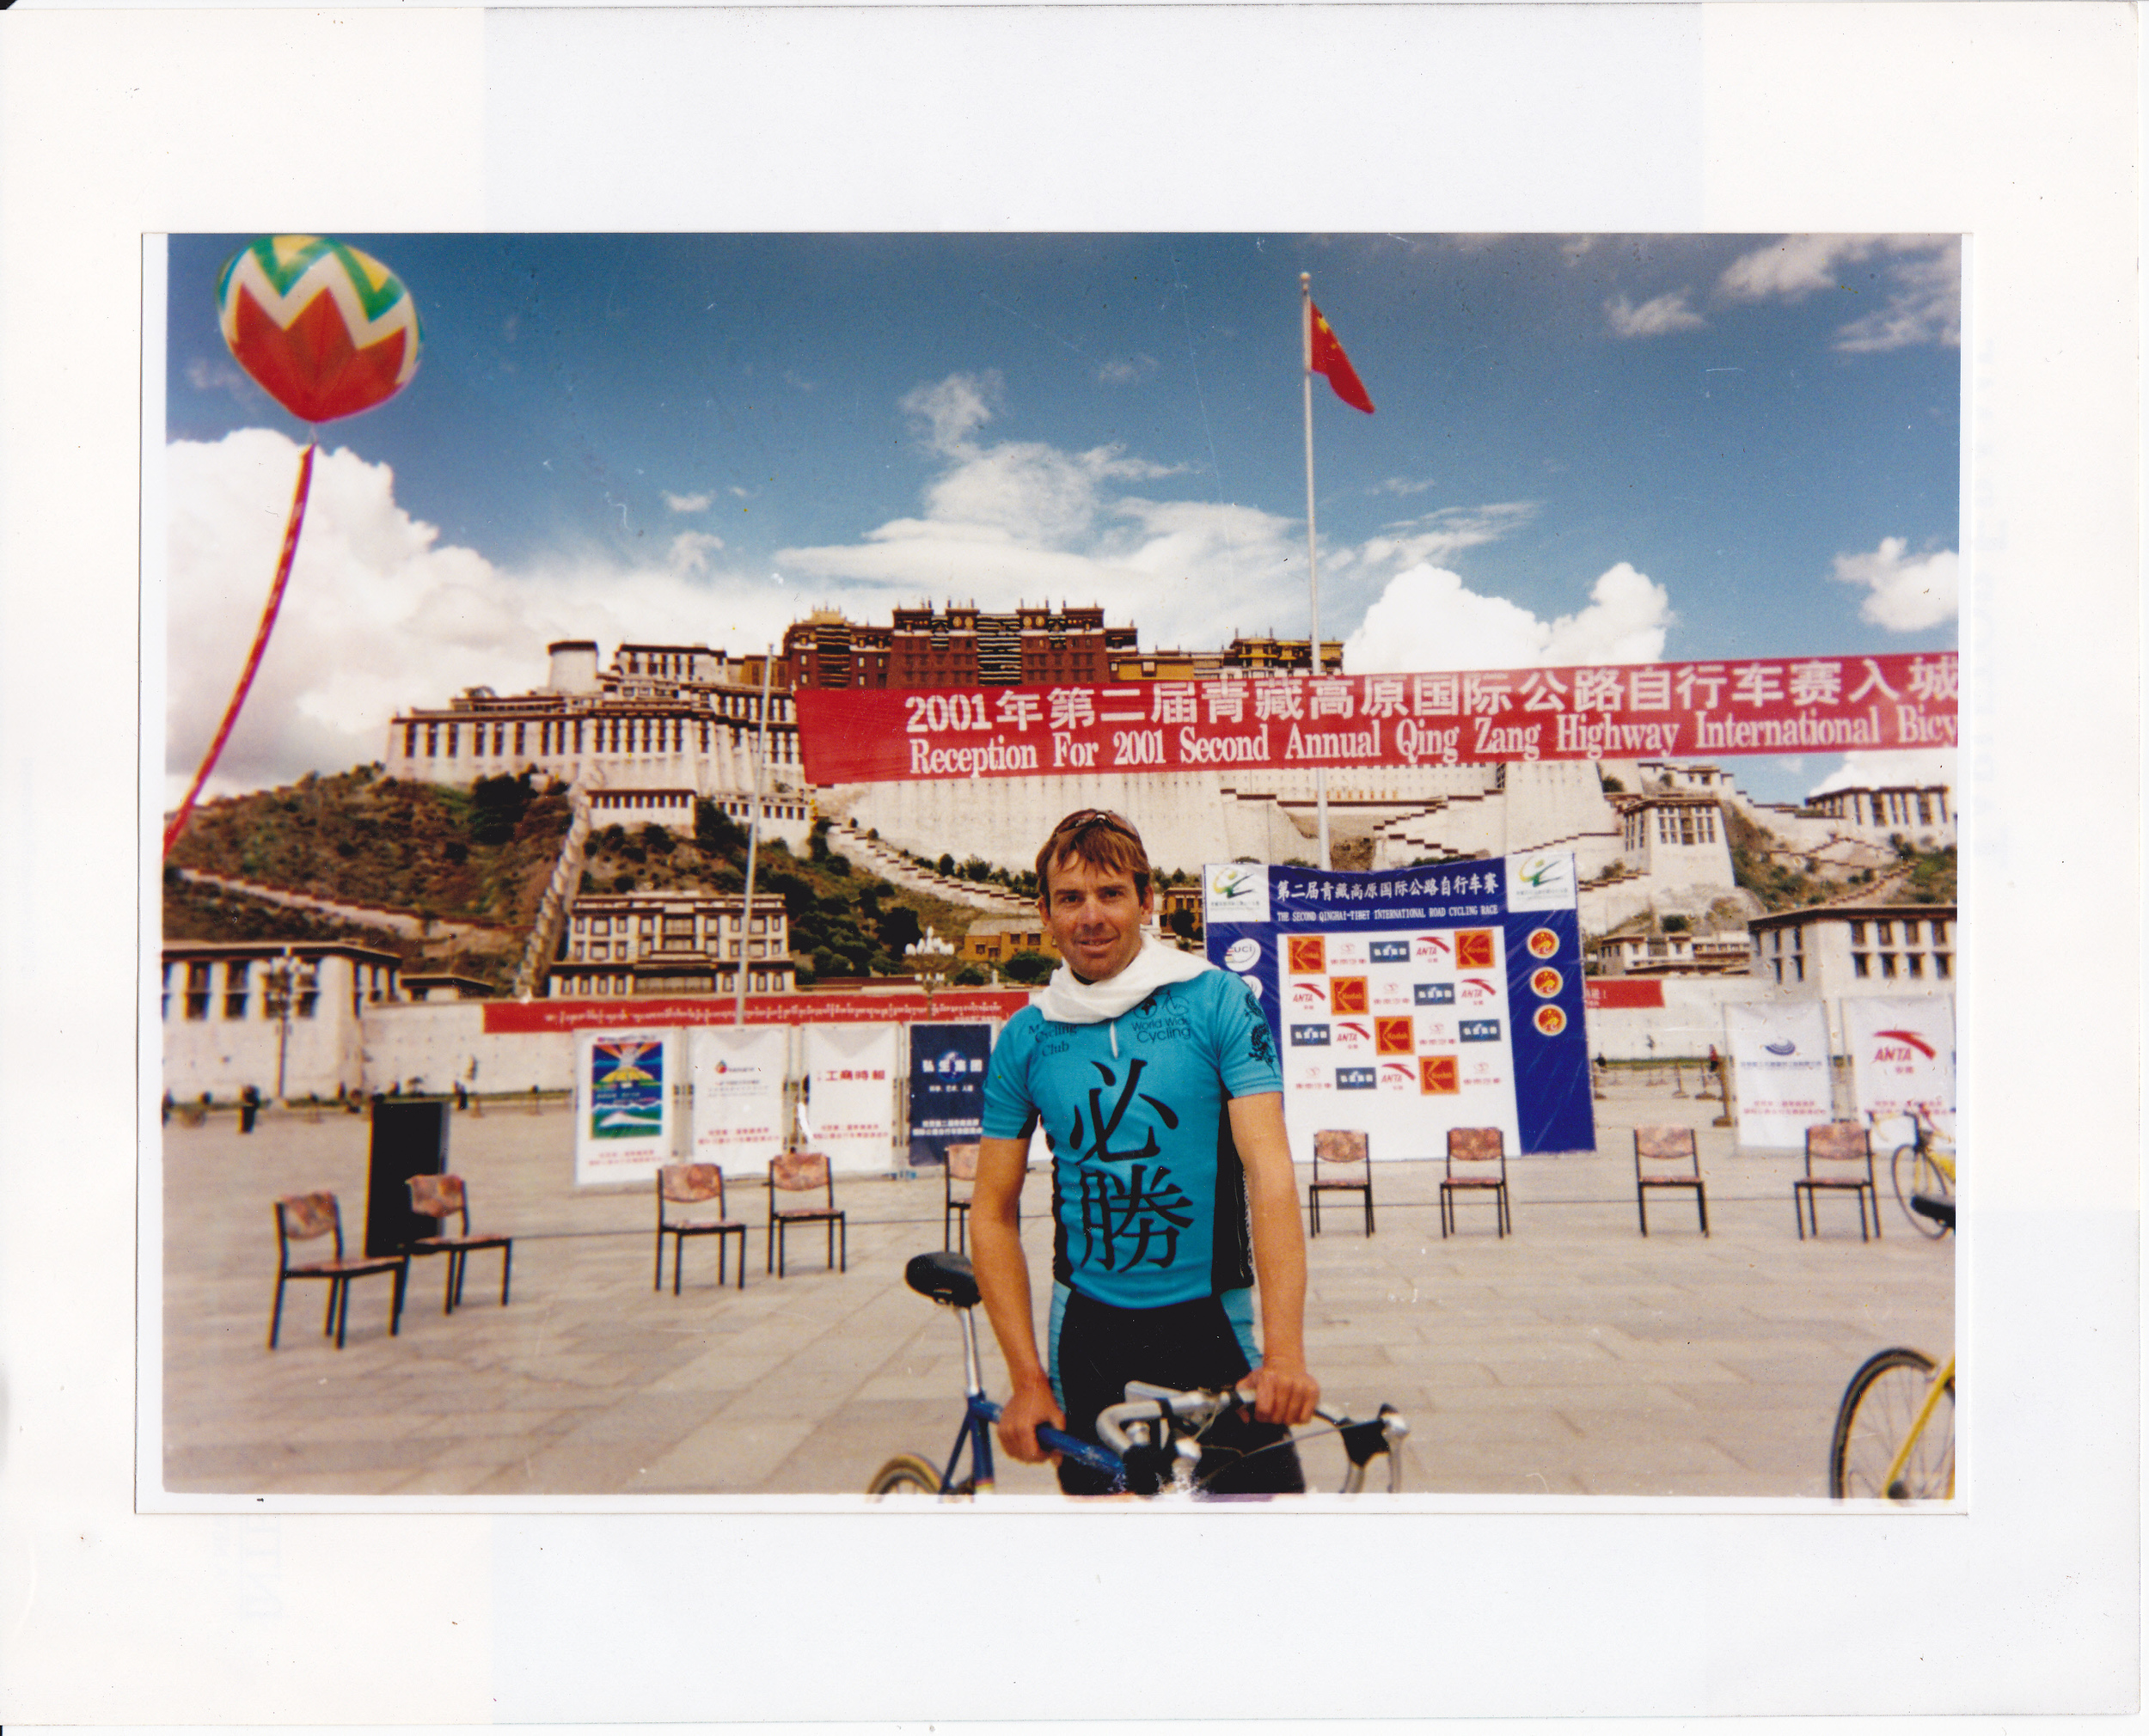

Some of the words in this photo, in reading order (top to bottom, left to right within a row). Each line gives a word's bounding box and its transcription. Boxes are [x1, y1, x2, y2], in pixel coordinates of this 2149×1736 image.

[904, 654, 1958, 732] 2001年第二届青藏高原国际公路自行车赛入城
[909, 735, 1037, 778] Reception
[1053, 730, 1099, 769] For
[1113, 729, 1166, 766] 2001
[1180, 724, 1270, 764] Second
[1285, 717, 1381, 759] Annual
[1396, 717, 1460, 763] Qing
[1474, 717, 1541, 761] Zang
[1557, 712, 1680, 760] Highway
[1695, 705, 1880, 749] International
[1277, 872, 1499, 902] 第二届青藏高原国际公路自行车赛
[1277, 911, 1289, 922] THE
[1292, 911, 1317, 922] SECOND
[1375, 907, 1426, 920] INTERNATIONAL
[1429, 908, 1446, 917] ROAD
[1448, 905, 1479, 917] CYCLING
[1481, 904, 1498, 915] RACE
[1416, 947, 1437, 956] ANTA
[1293, 993, 1313, 1002] ANTA
[1461, 989, 1483, 998] ANTA
[1132, 1020, 1161, 1031] World
[1137, 1027, 1191, 1043] Cycling
[1337, 1033, 1357, 1042] ANTA
[1042, 1041, 1070, 1057] Club
[1875, 1048, 1912, 1061] ANTA
[1069, 1058, 1194, 1274] 必勝
